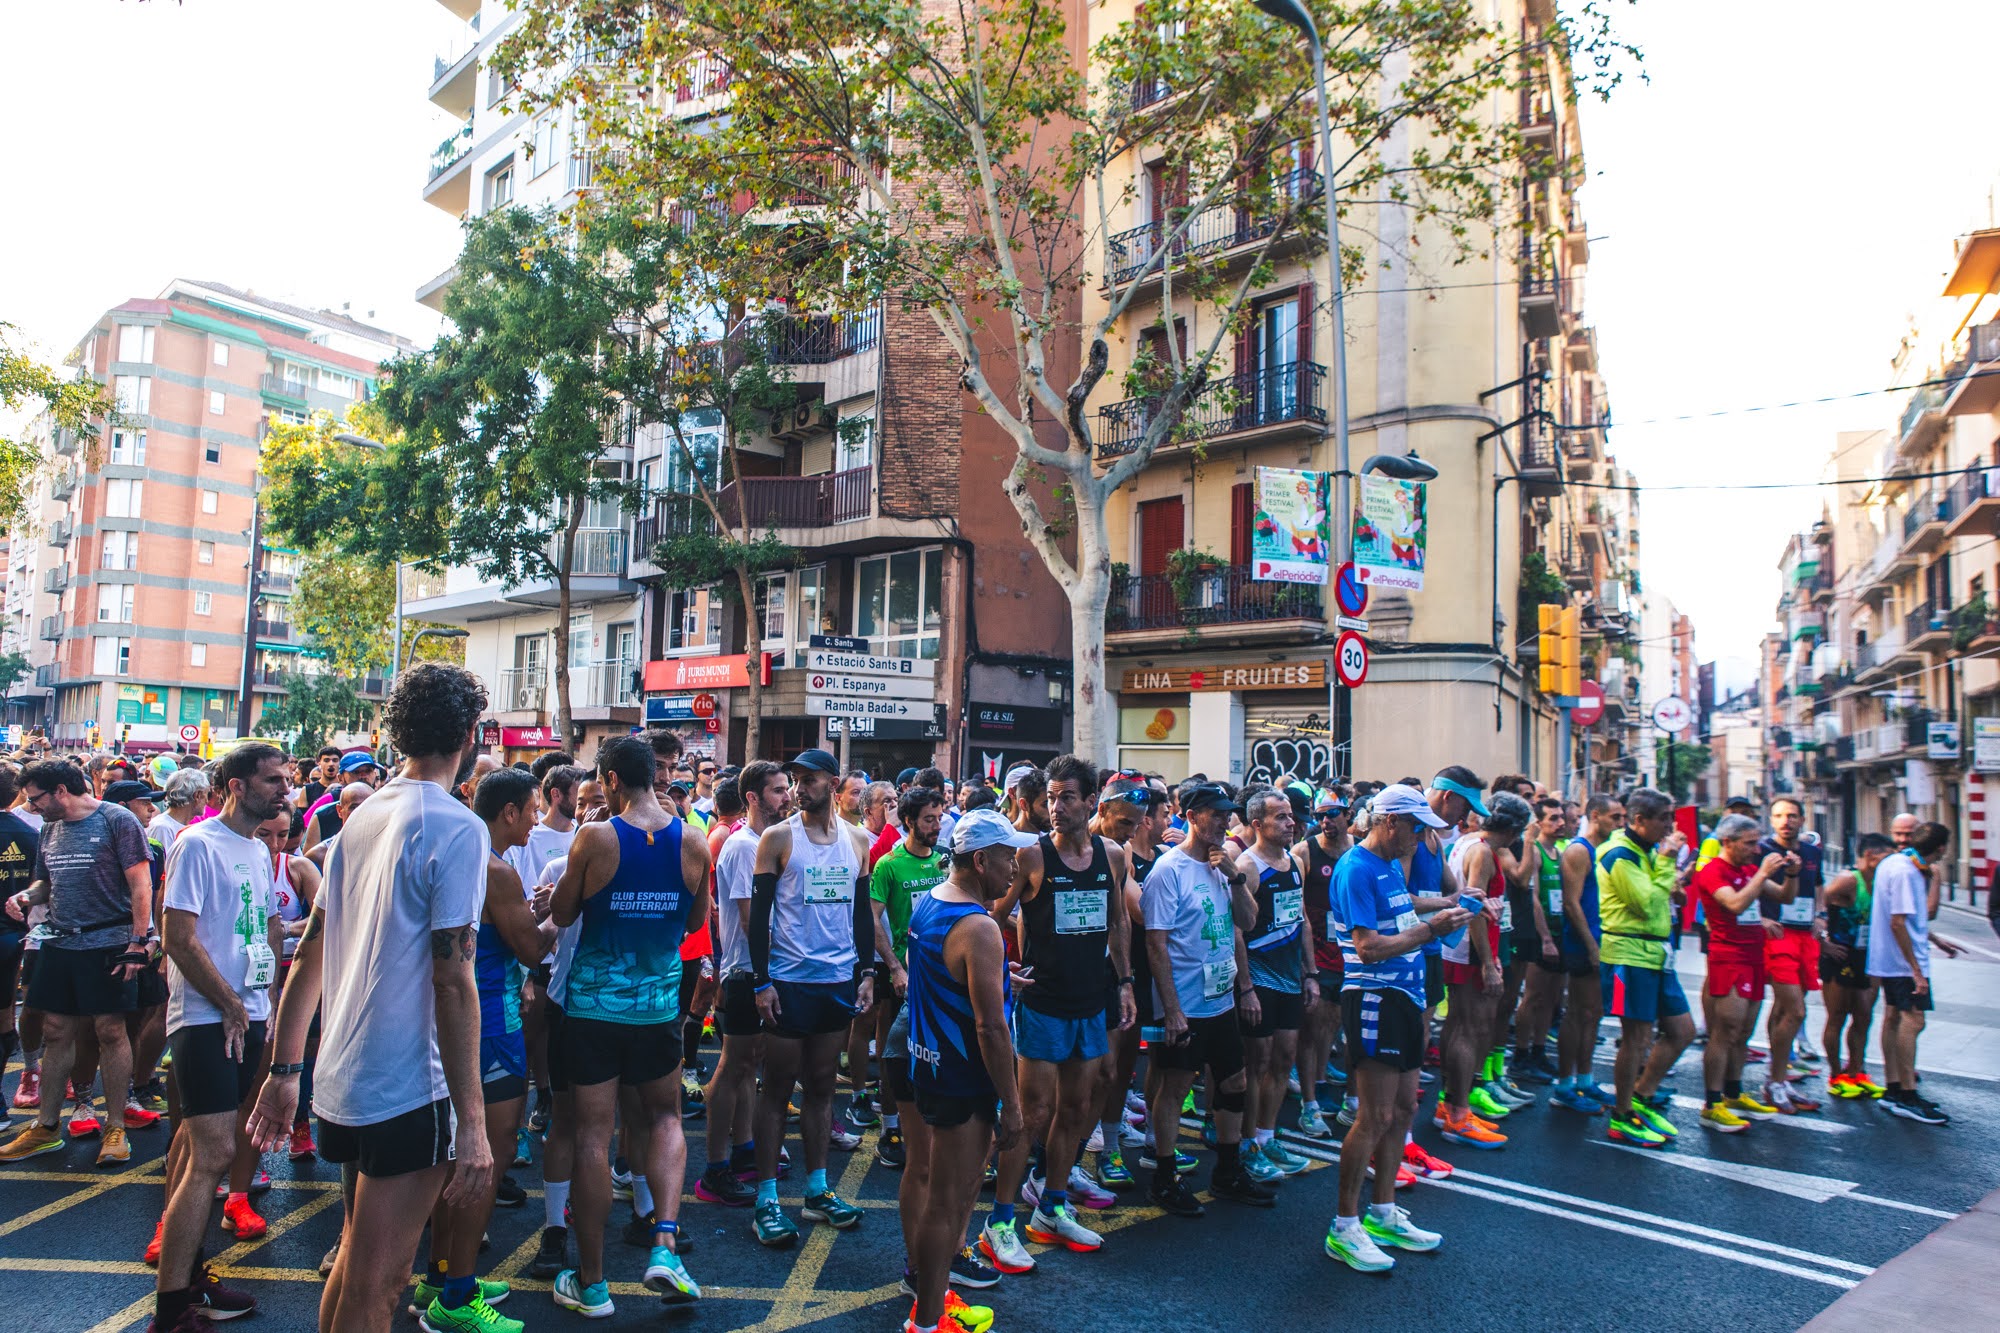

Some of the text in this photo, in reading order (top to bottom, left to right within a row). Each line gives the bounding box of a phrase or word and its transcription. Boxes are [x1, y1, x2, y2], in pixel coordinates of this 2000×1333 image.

[1265, 490, 1290, 498] PRIMER
[1265, 499, 1295, 508] FESTIVAL
[1366, 496, 1390, 504] PRIMER
[1366, 505, 1394, 514] FESTIVAL
[1274, 570, 1322, 582] elPeriódico
[1373, 574, 1420, 589] elPeriódico
[824, 638, 854, 648] C. Sants
[827, 654, 898, 670] Estació Sants
[1344, 648, 1362, 670] 30
[688, 664, 730, 677] IURIS MUNDI
[1133, 666, 1310, 689] LINA FRUITES
[826, 678, 886, 692] Pl. Espanya
[696, 697, 712, 710] ria
[825, 700, 896, 714] Rambla Badal
[980, 710, 1014, 722] GE & SIL
[1096, 874, 1107, 882] NB
[612, 892, 680, 900] CLUB ESPORTIU
[824, 888, 836, 898] 26
[610, 901, 678, 910] MEDITERRANI
[1078, 916, 1086, 926] 11
